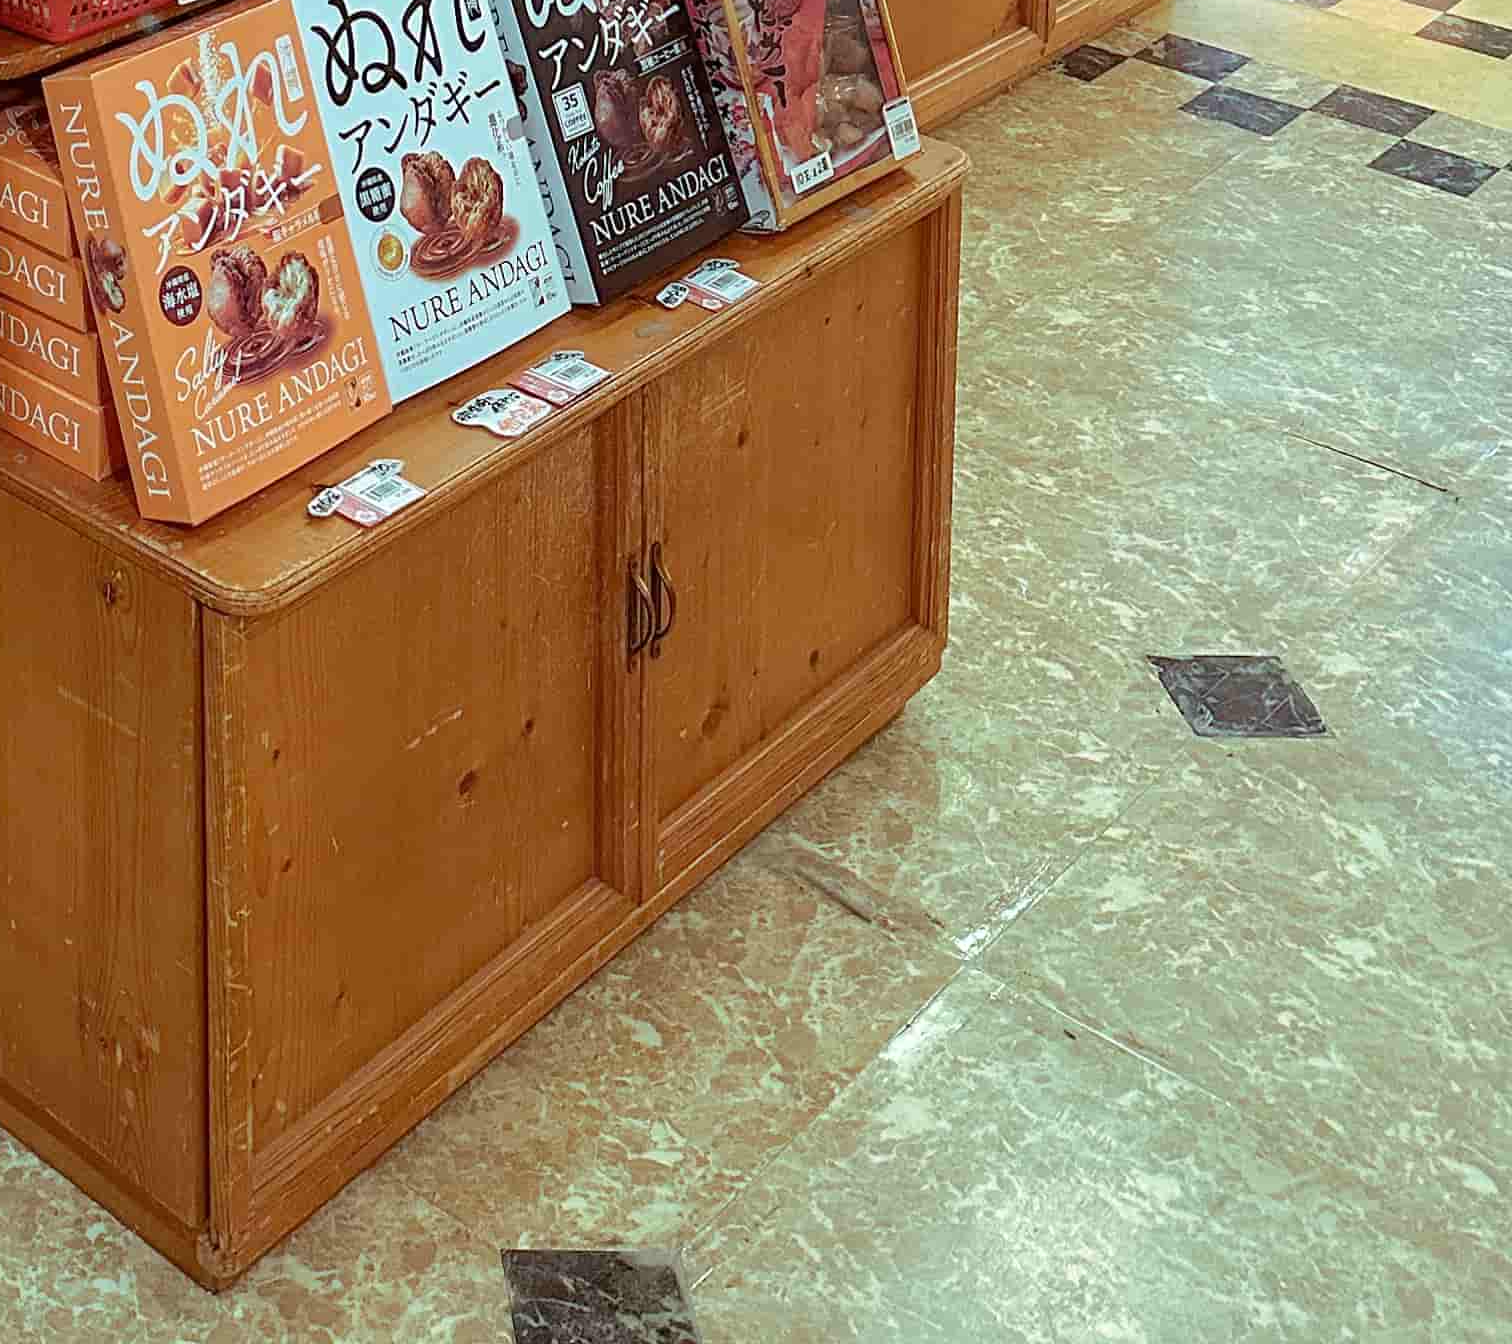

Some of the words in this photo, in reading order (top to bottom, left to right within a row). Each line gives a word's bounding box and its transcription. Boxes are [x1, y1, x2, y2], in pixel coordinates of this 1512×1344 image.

[115, 40, 309, 202] ぬれ
[338, 70, 502, 175] アンダギー
[561, 95, 580, 112] 35
[142, 162, 322, 275] アンダギー
[589, 195, 654, 247] NURE
[656, 153, 729, 218] ANDAGI
[58, 102, 109, 233] NURE
[109, 318, 172, 500] ANDAGI
[387, 281, 465, 343] NURE
[466, 239, 550, 305] ANDAGI
[174, 328, 226, 403] Salty
[190, 392, 272, 457] NURE
[274, 335, 370, 408] ANDAGI
